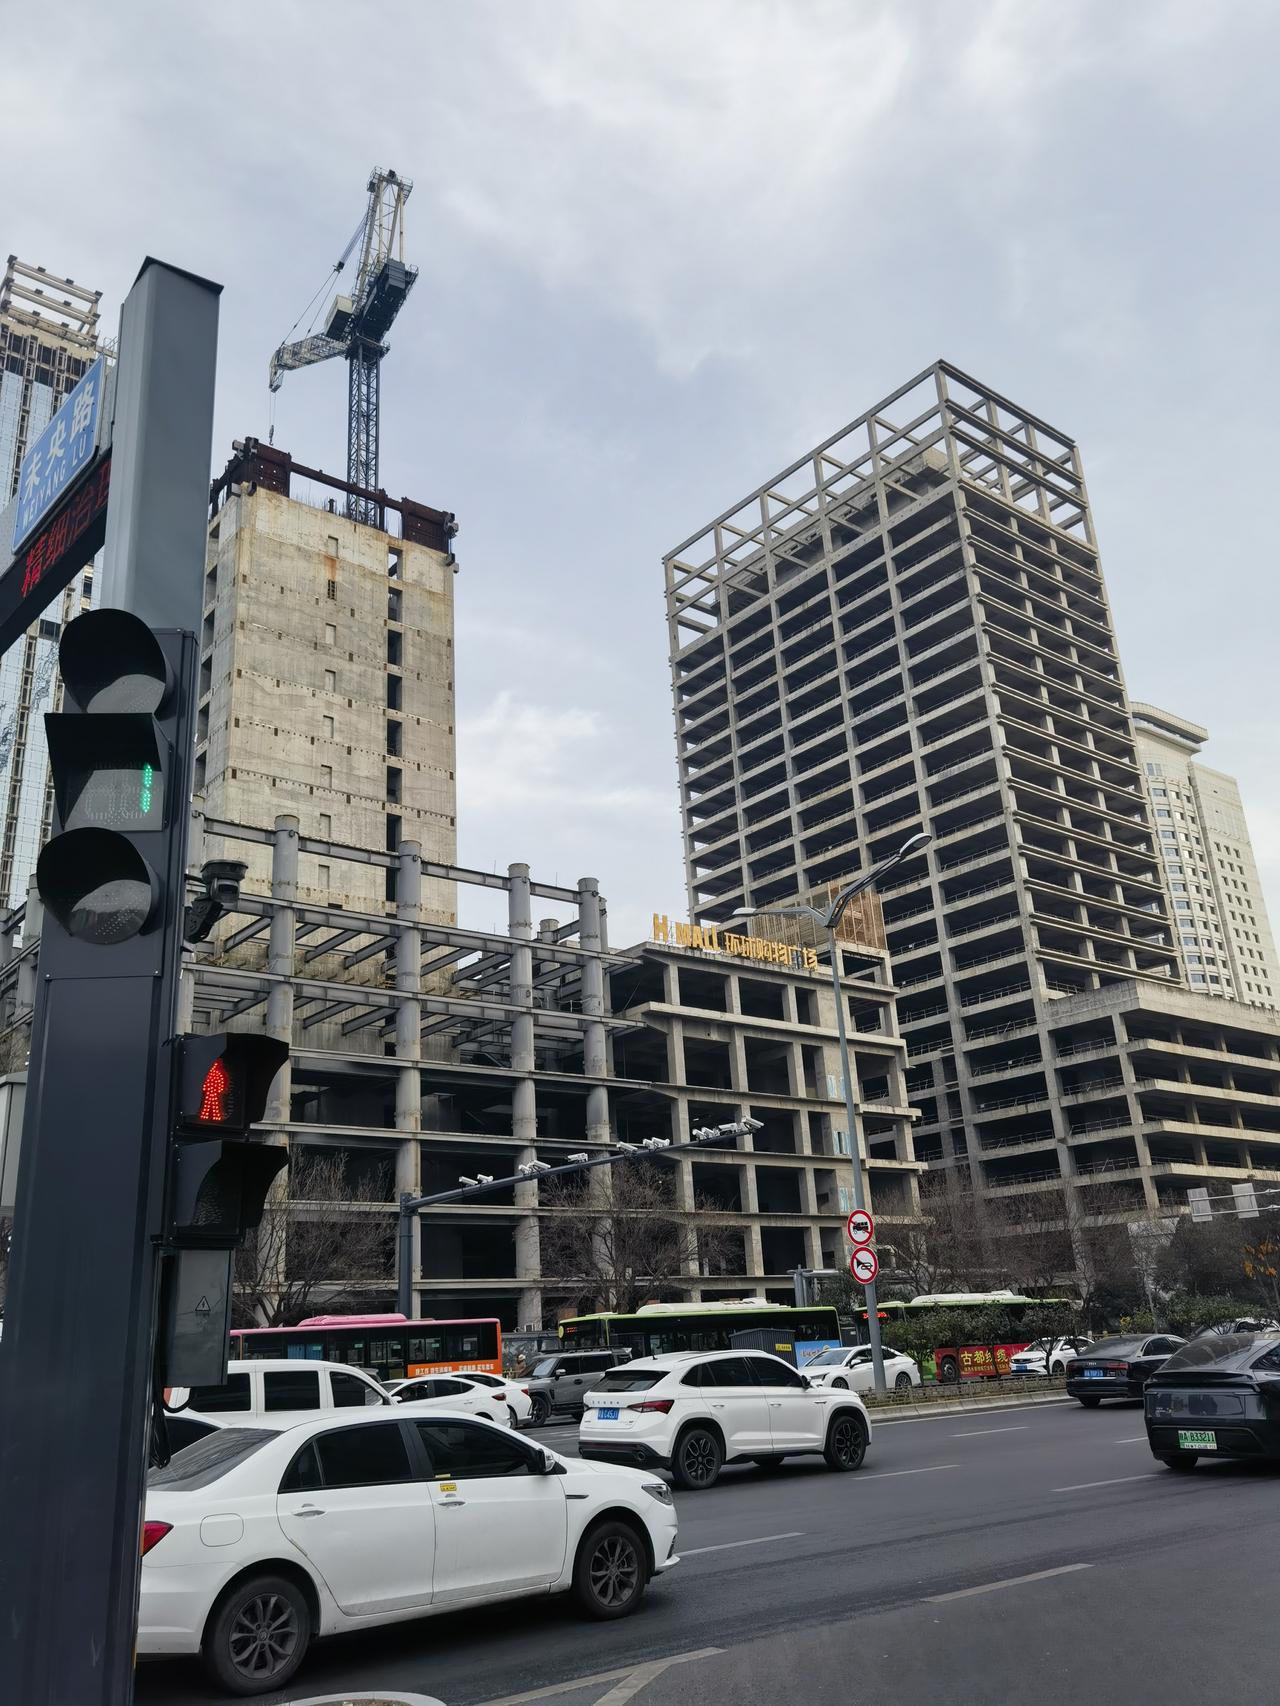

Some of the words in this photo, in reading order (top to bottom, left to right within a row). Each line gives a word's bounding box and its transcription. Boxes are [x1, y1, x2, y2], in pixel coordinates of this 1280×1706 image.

[22, 458, 66, 530] WEIYANG
[72, 433, 87, 466] LU
[23, 381, 95, 504] 未央路
[653, 912, 668, 943] H
[675, 921, 720, 950] MALL
